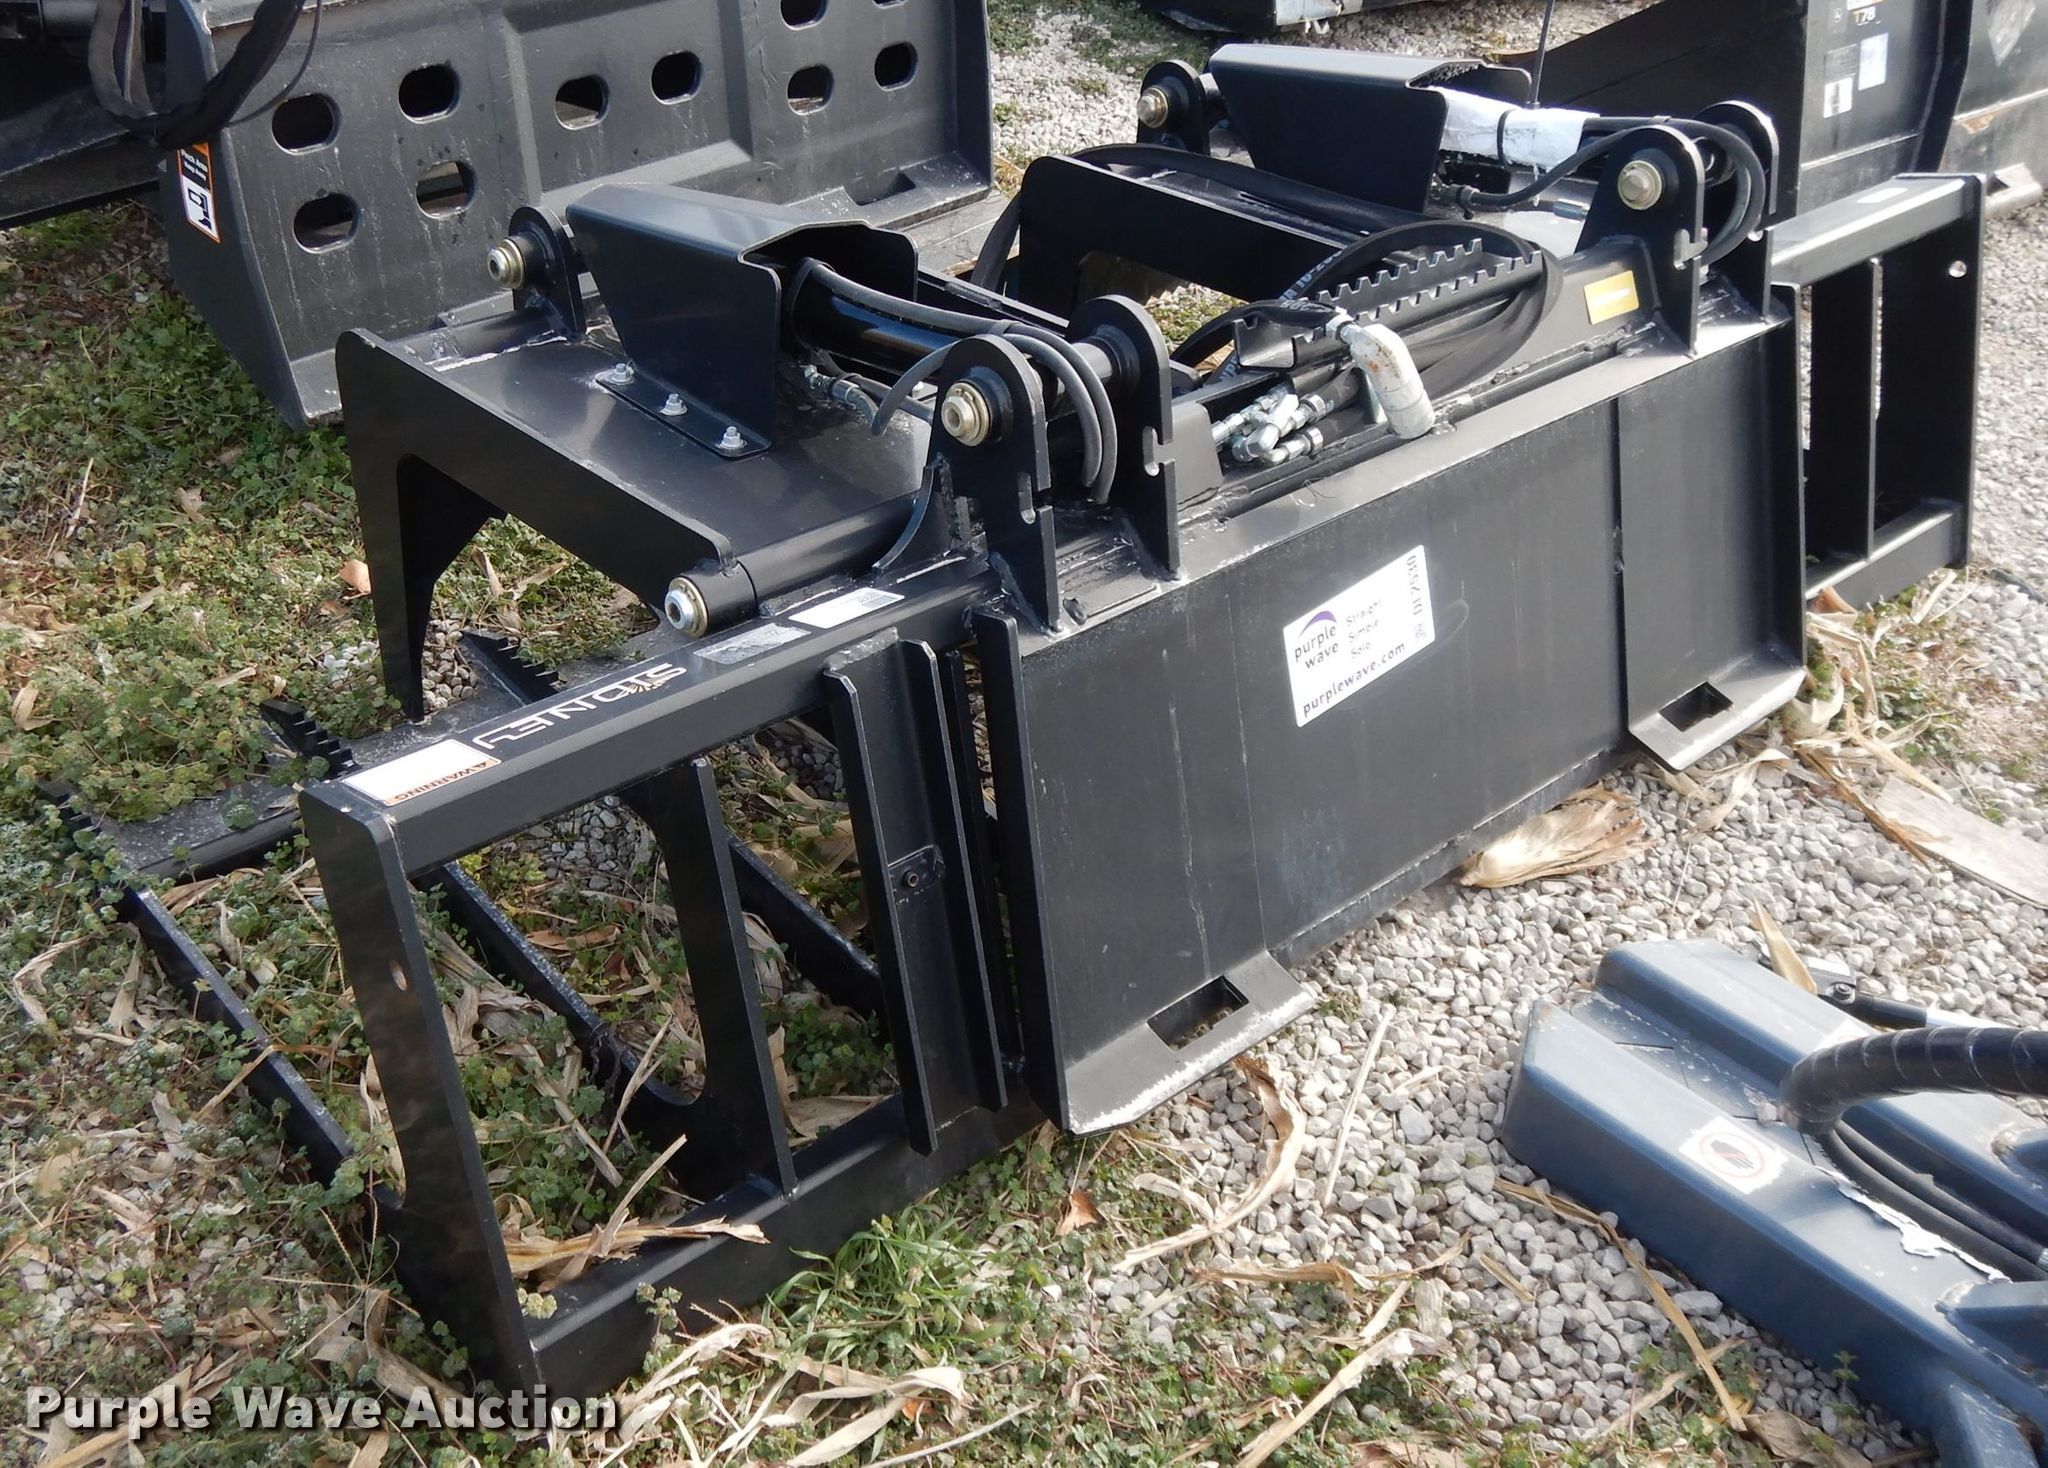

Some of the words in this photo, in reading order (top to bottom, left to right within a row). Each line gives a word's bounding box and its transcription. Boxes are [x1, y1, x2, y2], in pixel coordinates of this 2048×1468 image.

[1294, 624, 1337, 662] purple
[1304, 642, 1339, 669] wave
[1303, 643, 1405, 717] purplewave.com
[395, 768, 475, 800] WARNING
